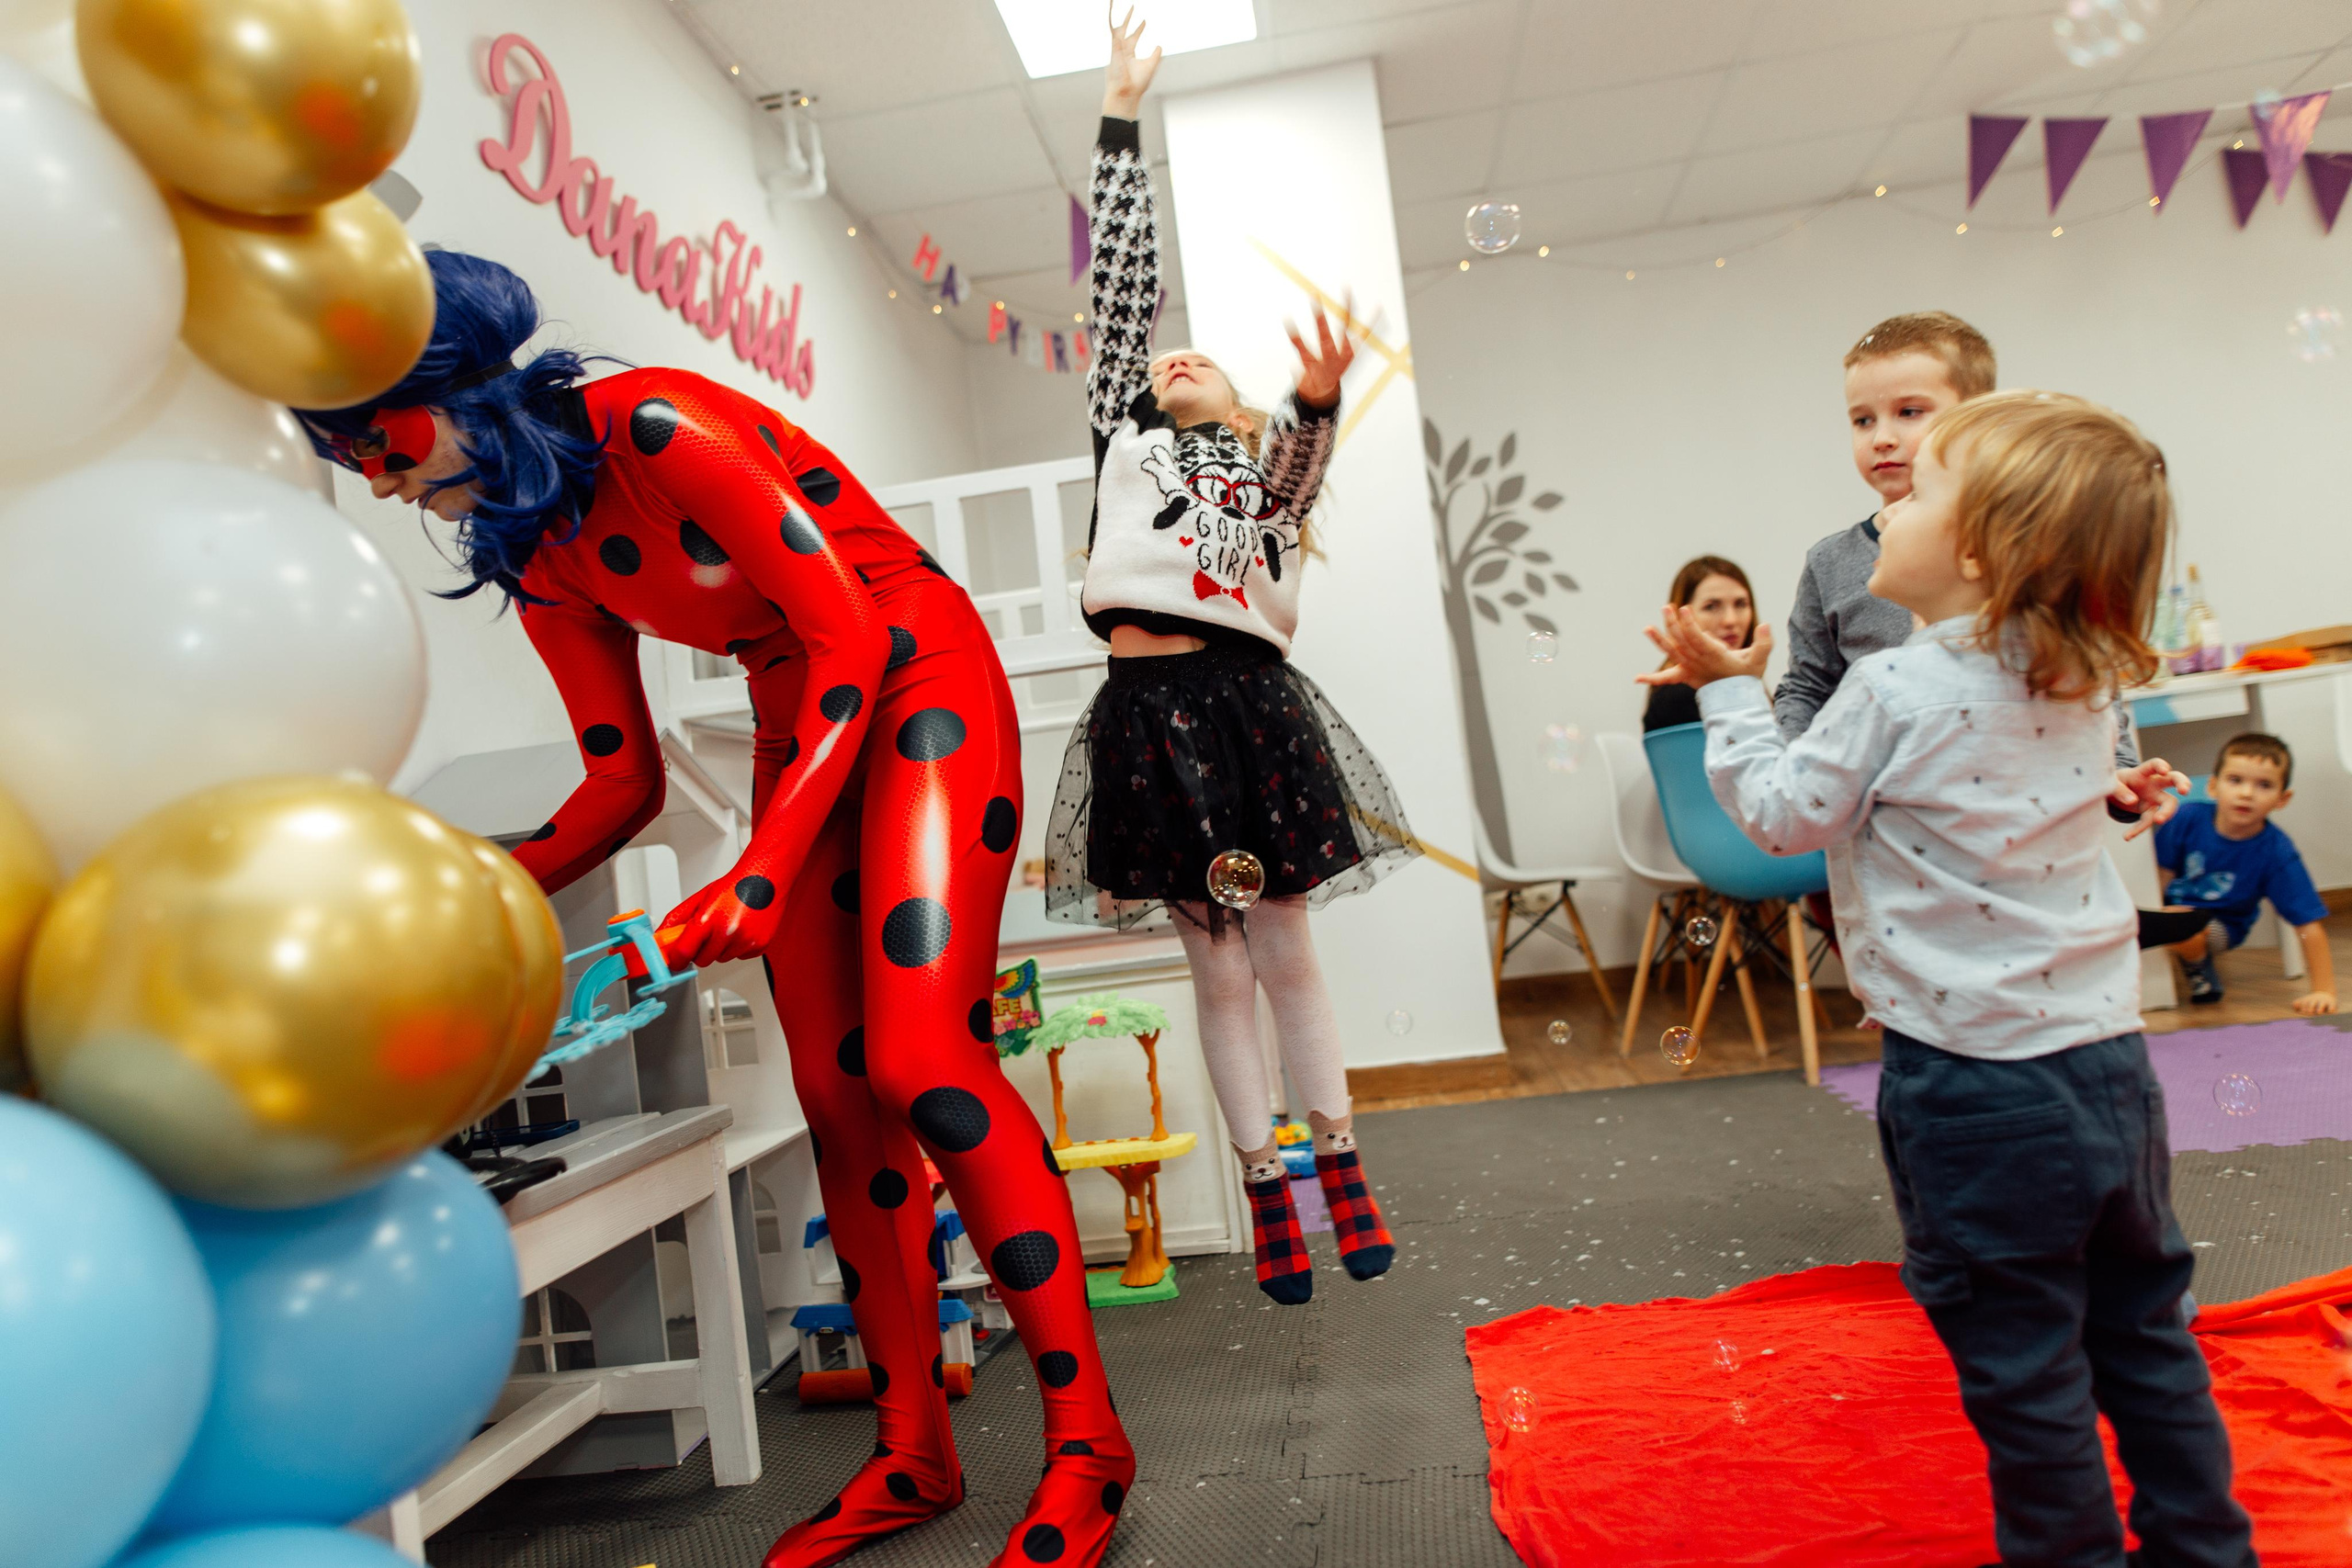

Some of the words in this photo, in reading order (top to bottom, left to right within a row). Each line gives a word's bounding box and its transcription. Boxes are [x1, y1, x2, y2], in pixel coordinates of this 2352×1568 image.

[480, 33, 815, 400] DanaKids
[1196, 511, 1258, 553] GOOD
[1197, 543, 1250, 586] GIRL
